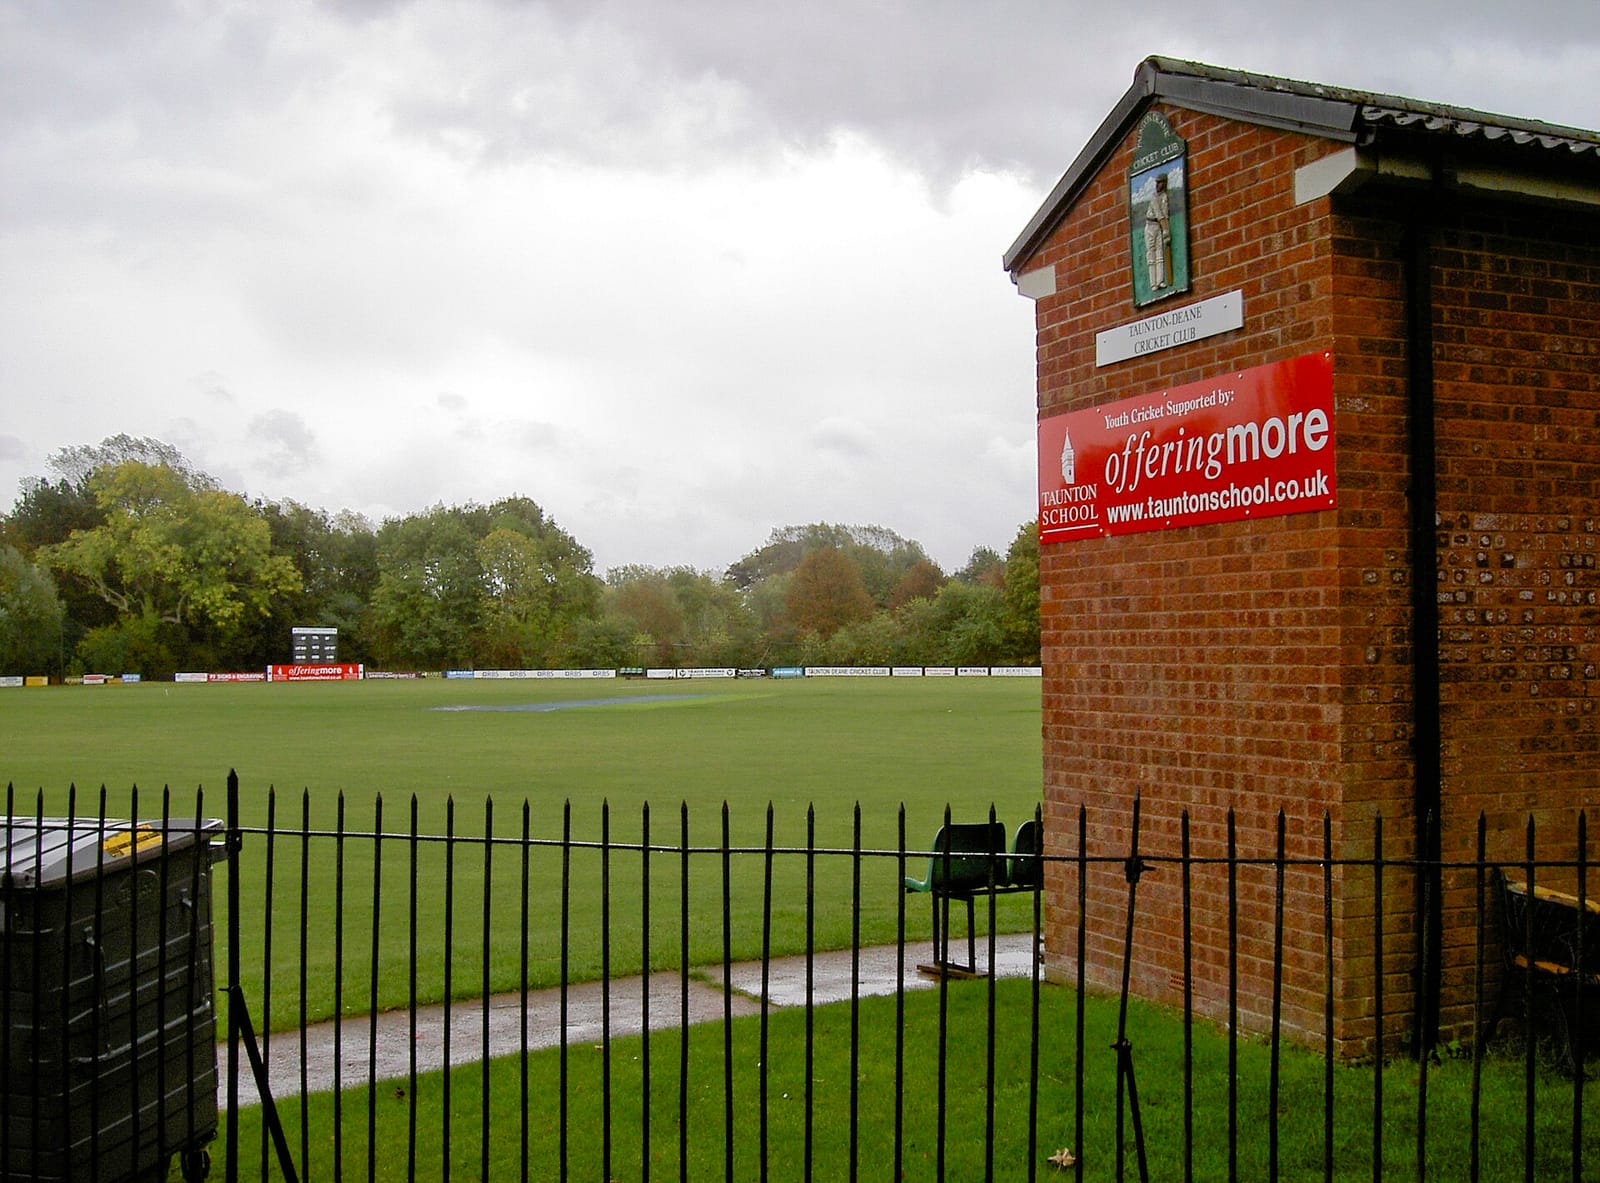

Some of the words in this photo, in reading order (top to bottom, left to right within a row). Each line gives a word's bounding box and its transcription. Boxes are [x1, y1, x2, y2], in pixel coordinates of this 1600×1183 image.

[1134, 151, 1159, 169] CRICKET
[1160, 142, 1179, 156] CLUB
[1134, 333, 1171, 354] CRICKET
[1173, 327, 1196, 344] CLUB
[1104, 415, 1129, 429] Youth
[1130, 405, 1164, 424] Cricket
[1166, 390, 1216, 416] Supported
[1218, 388, 1235, 407] by:
[1105, 408, 1329, 494] offeringmore
[1041, 483, 1098, 507] TAUNTON
[1106, 469, 1330, 524] www.tauntonschool.co.uk
[1042, 504, 1099, 526] SCHOOL
